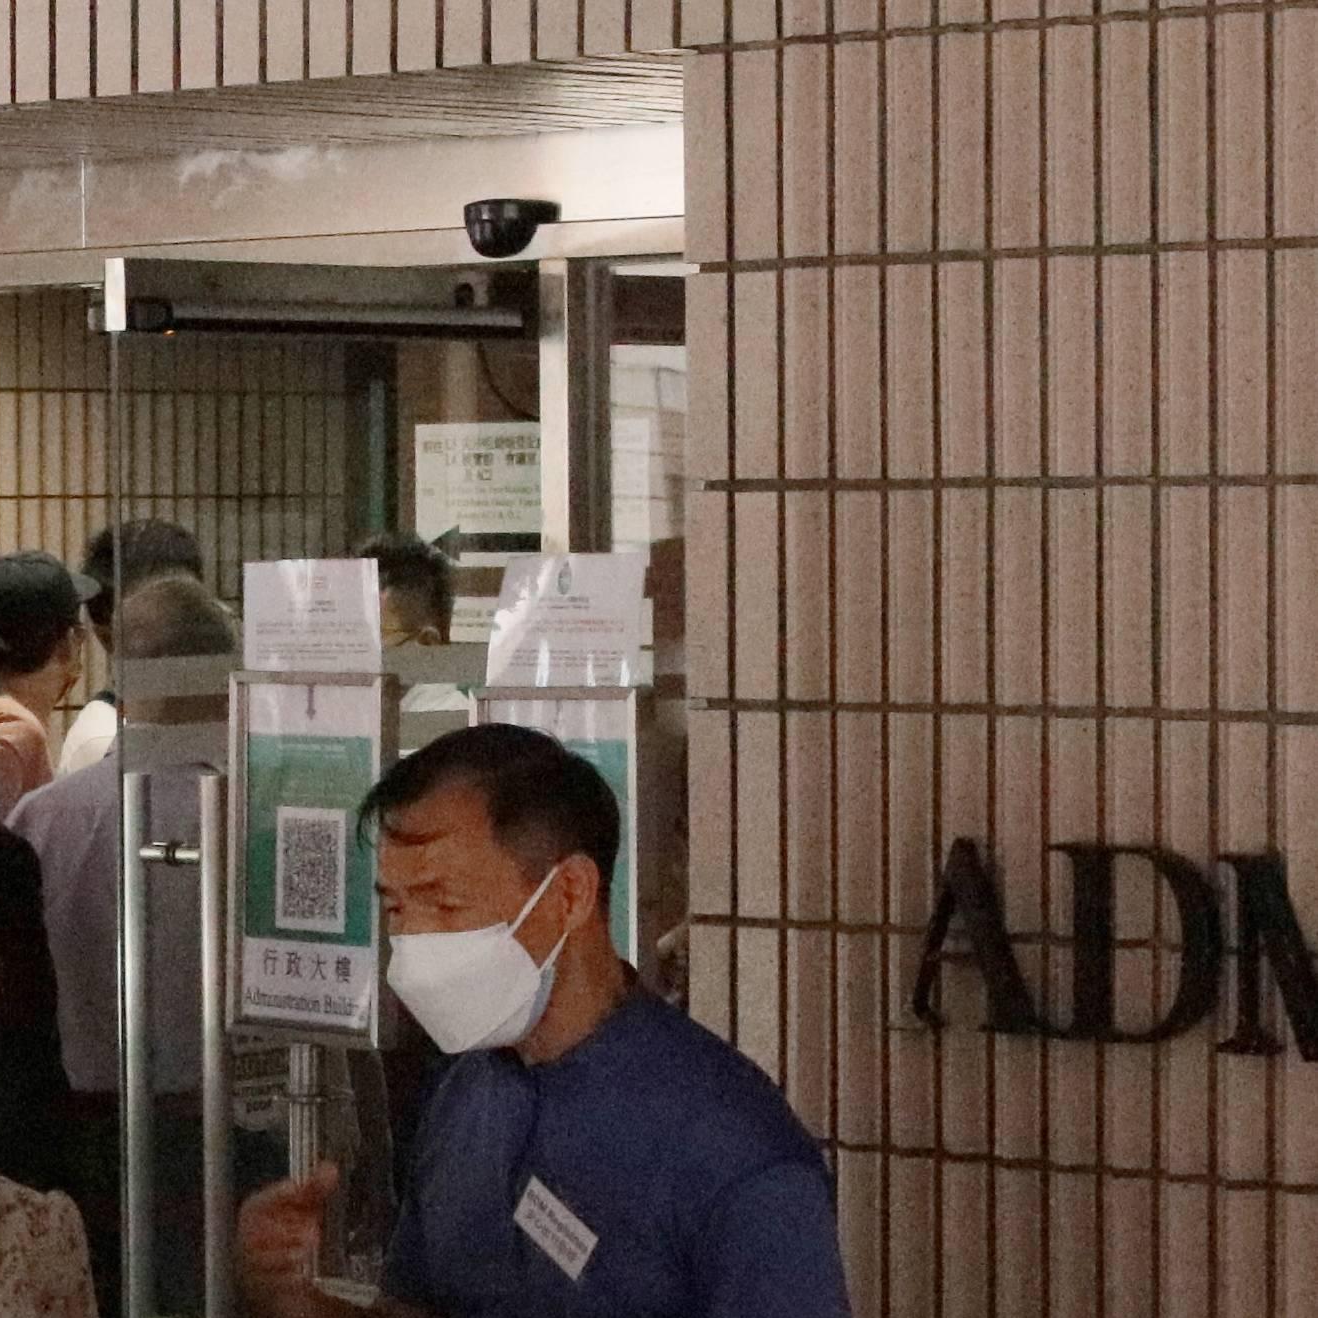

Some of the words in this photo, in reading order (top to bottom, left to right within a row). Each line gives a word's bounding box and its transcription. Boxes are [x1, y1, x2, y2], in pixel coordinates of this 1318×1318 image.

[262, 947, 353, 985] 行政大樓
[245, 987, 320, 1012] Administration
